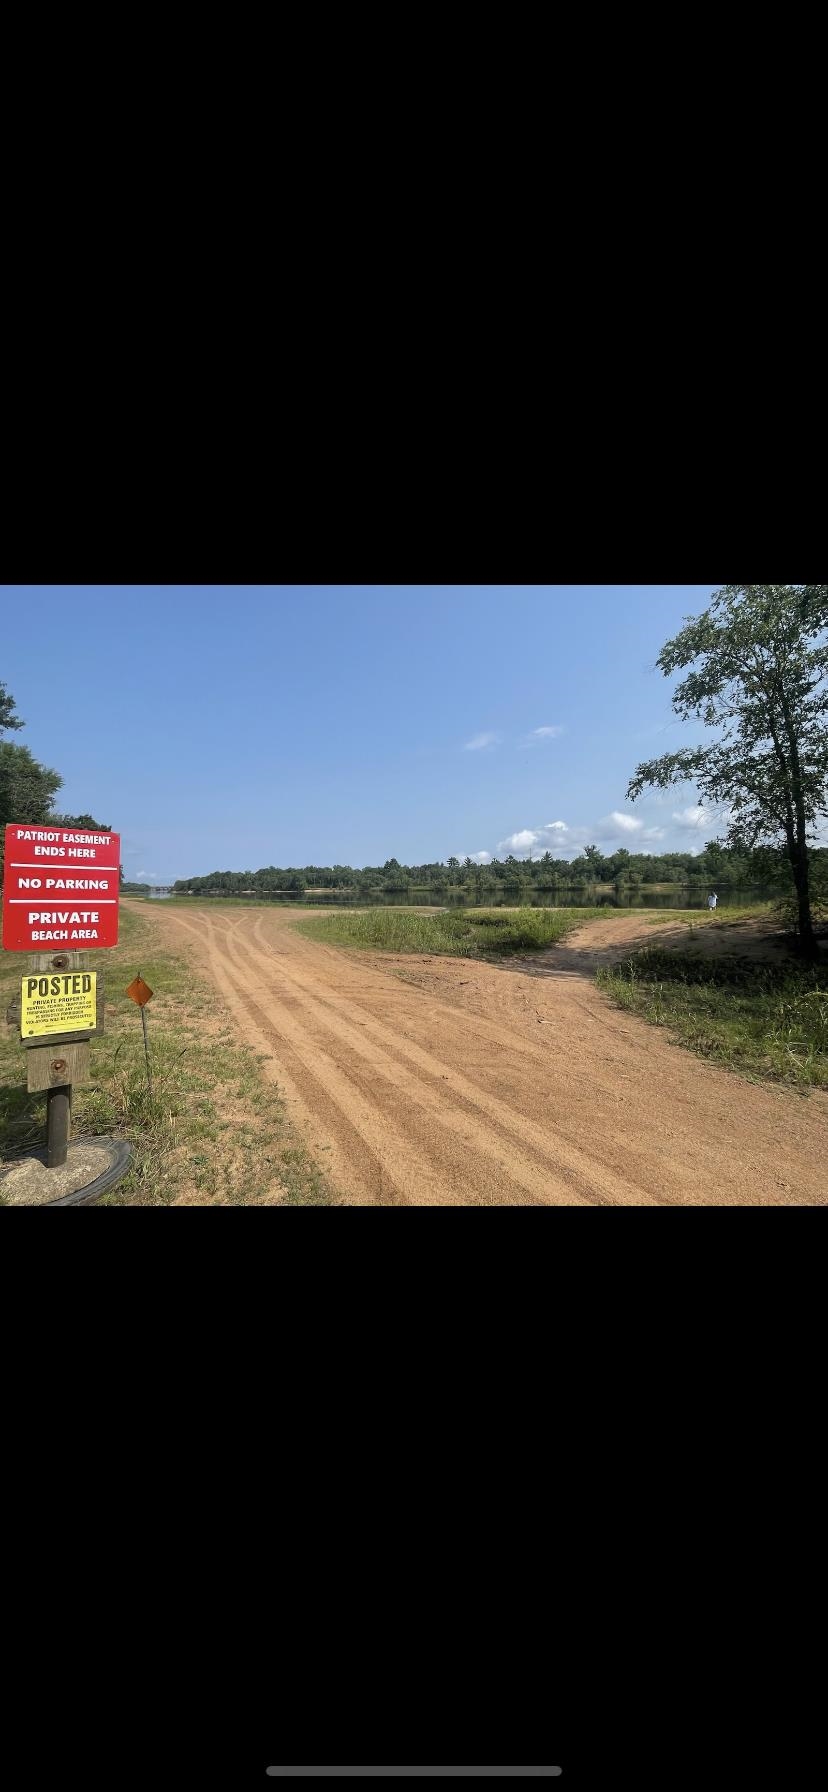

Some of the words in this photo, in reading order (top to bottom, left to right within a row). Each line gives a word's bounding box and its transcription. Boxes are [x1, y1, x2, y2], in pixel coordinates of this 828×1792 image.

[17, 830, 60, 842] PATRIOT
[62, 833, 111, 845] EASEMENT
[34, 846, 66, 856] ENDS
[68, 848, 96, 858] HERE
[18, 878, 41, 888] NO
[45, 878, 109, 890] PARKING
[28, 912, 100, 924] PRIVATE
[31, 930, 68, 940] BEACH
[71, 929, 98, 939] AREA
[27, 975, 91, 998] POSTED
